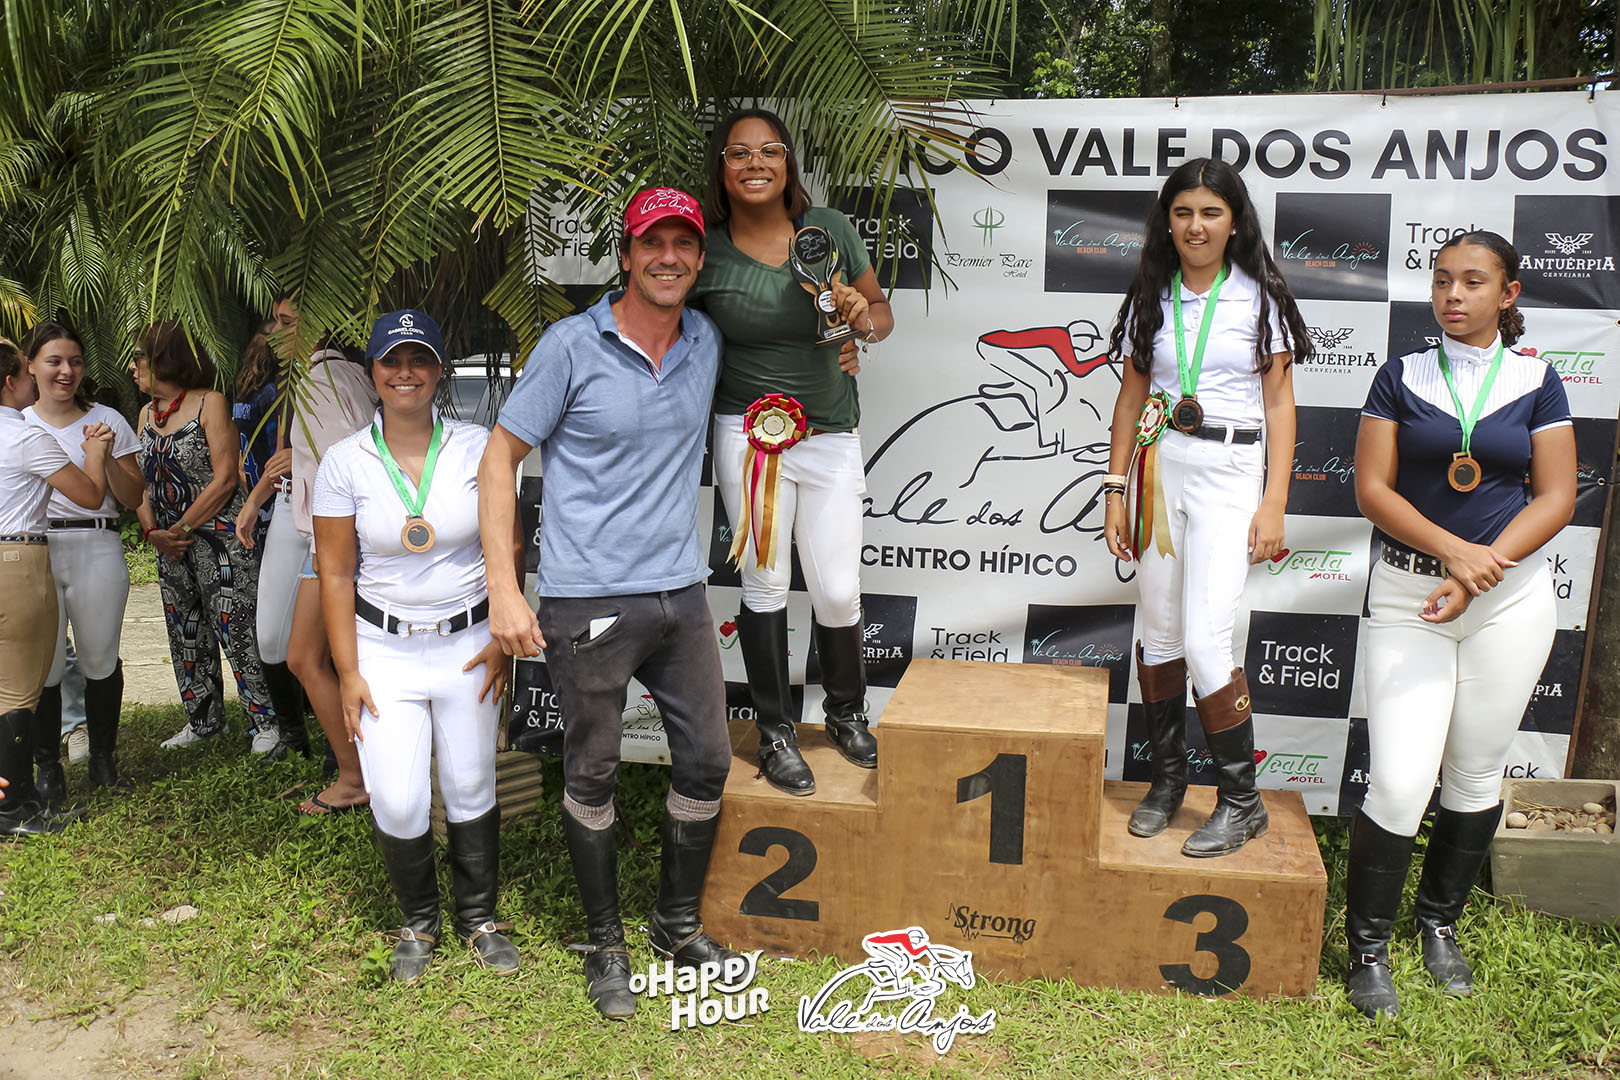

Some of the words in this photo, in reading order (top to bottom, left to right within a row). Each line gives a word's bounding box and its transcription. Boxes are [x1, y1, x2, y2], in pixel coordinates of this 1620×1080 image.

[1032, 128, 1187, 176] VALE
[1211, 128, 1351, 179] DOS
[1371, 128, 1608, 181] ANJOS
[1281, 228, 1314, 260] Vale
[945, 253, 994, 267] Premier
[1000, 253, 1033, 268] Parc
[1404, 248, 1422, 270] &
[1003, 269, 1028, 278] Hotel
[1562, 376, 1603, 384] MOTEL
[863, 471, 959, 526] ale
[966, 500, 1024, 526] dos
[861, 544, 971, 571] CENTRO
[979, 544, 1078, 577] HÍPICO
[1309, 573, 1352, 581] MOTEL
[931, 627, 1002, 645] Track
[1031, 628, 1063, 658] Vale
[1261, 641, 1334, 665] Track
[1258, 664, 1275, 686] &
[1280, 666, 1341, 689] Field
[527, 710, 541, 728] &
[1286, 776, 1326, 784] MOTEL
[956, 752, 1027, 866] 1
[737, 826, 819, 921] 2
[953, 905, 1037, 941] Strong
[1159, 894, 1251, 997] 3
